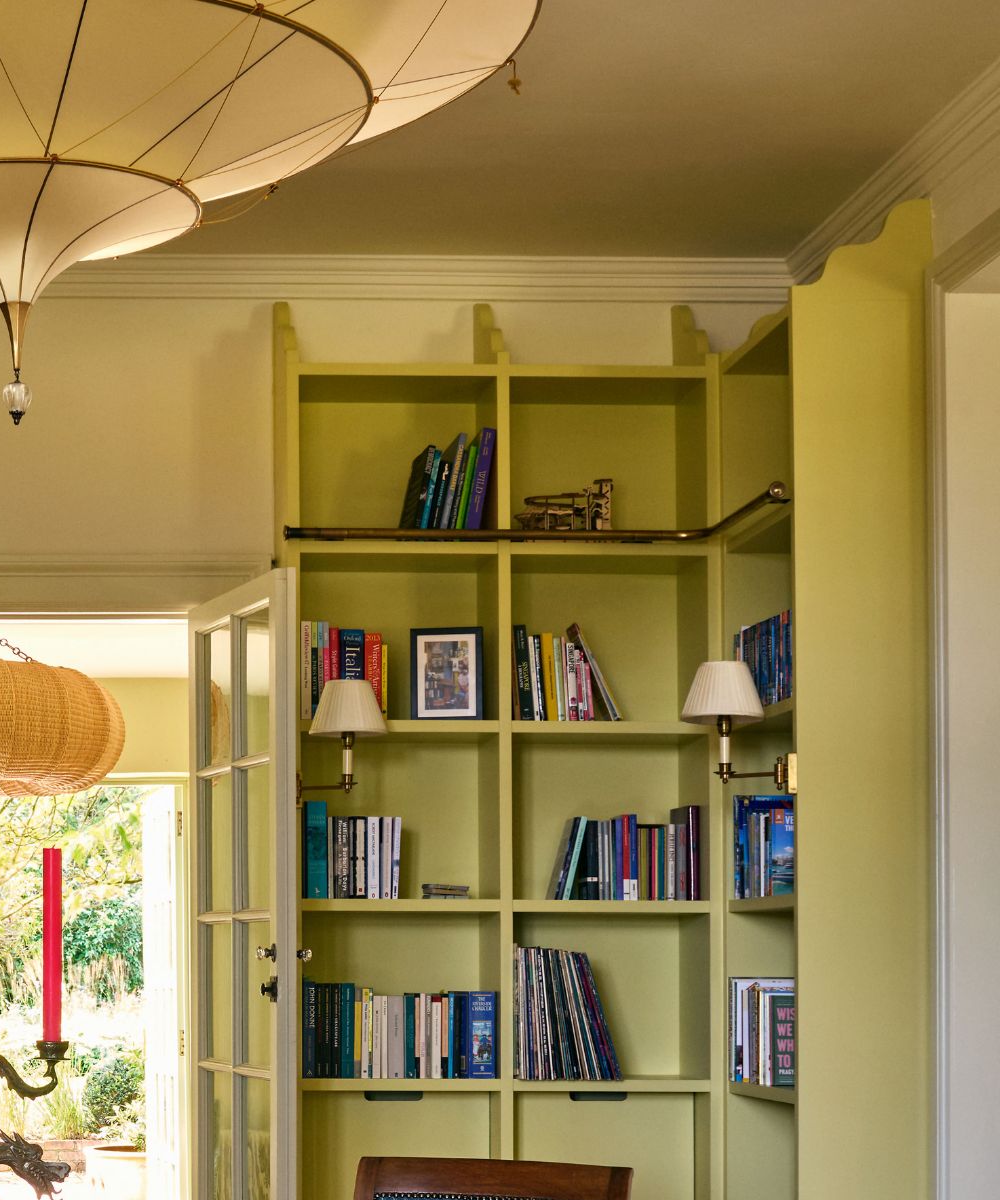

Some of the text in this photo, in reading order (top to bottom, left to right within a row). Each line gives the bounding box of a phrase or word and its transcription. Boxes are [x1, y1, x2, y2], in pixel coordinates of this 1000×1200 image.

[475, 470, 487, 494] WILD
[567, 645, 577, 674] SINGAPORE
[308, 986, 316, 1028] JOHN DONNE
[776, 1023, 793, 1037] WE
[776, 1039, 795, 1052] WH
[776, 1054, 791, 1068] TO
